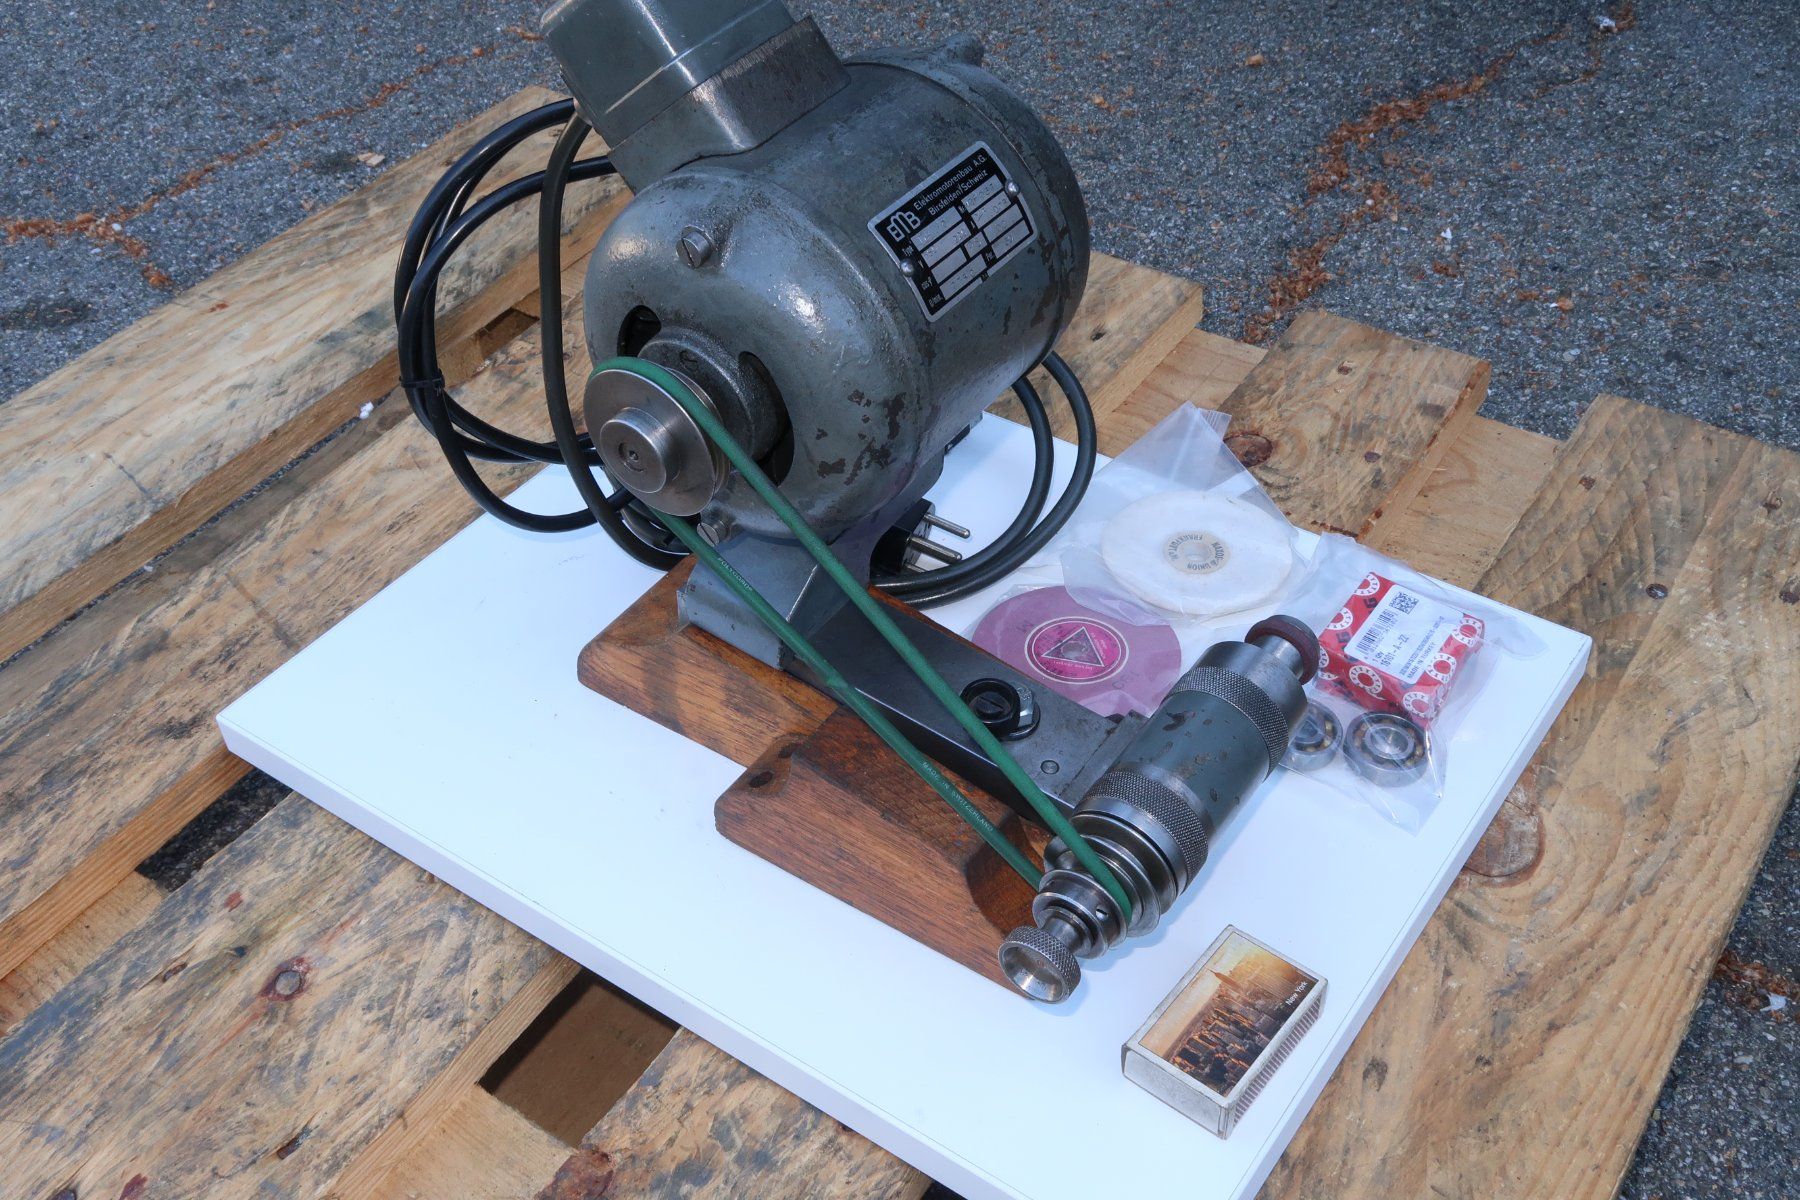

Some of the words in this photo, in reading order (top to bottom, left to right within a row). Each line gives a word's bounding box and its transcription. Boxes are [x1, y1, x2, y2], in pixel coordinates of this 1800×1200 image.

[913, 166, 973, 211] Elektromotorenbau
[1187, 563, 1211, 571] UNION
[922, 761, 939, 779] MADE
[951, 790, 994, 831] SWITZERLAND
[1285, 992, 1299, 1006] New
[1294, 980, 1308, 993] York
